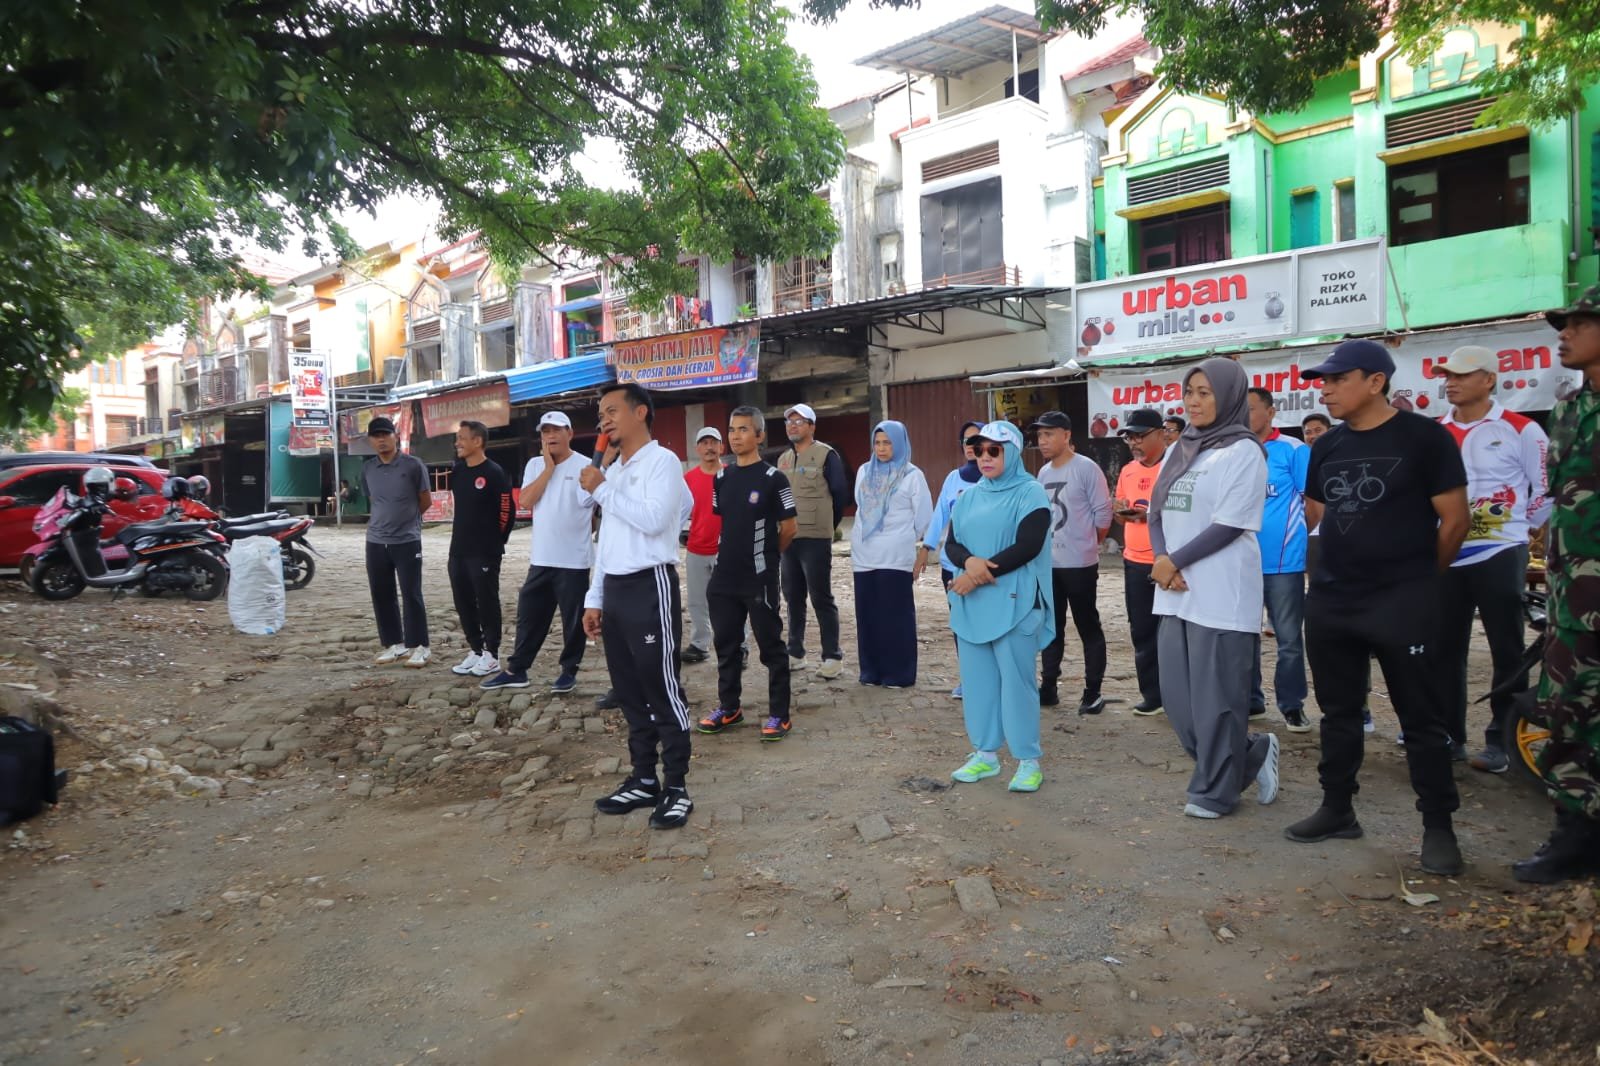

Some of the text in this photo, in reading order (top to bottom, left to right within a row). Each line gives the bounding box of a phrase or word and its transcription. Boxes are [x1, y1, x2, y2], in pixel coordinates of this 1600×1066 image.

[1319, 281, 1358, 296] RIZKY
[1321, 270, 1356, 283] TOKO
[1122, 273, 1248, 316] urban
[1310, 293, 1368, 308] PALAKKA
[1138, 307, 1196, 338] mild
[617, 335, 714, 367] TOKO FATMA JAYA
[1422, 345, 1552, 380] uan
[636, 366, 663, 380] GROSIR
[665, 364, 683, 377] DAN
[685, 361, 715, 375] ECERAN
[1112, 379, 1184, 406] urba
